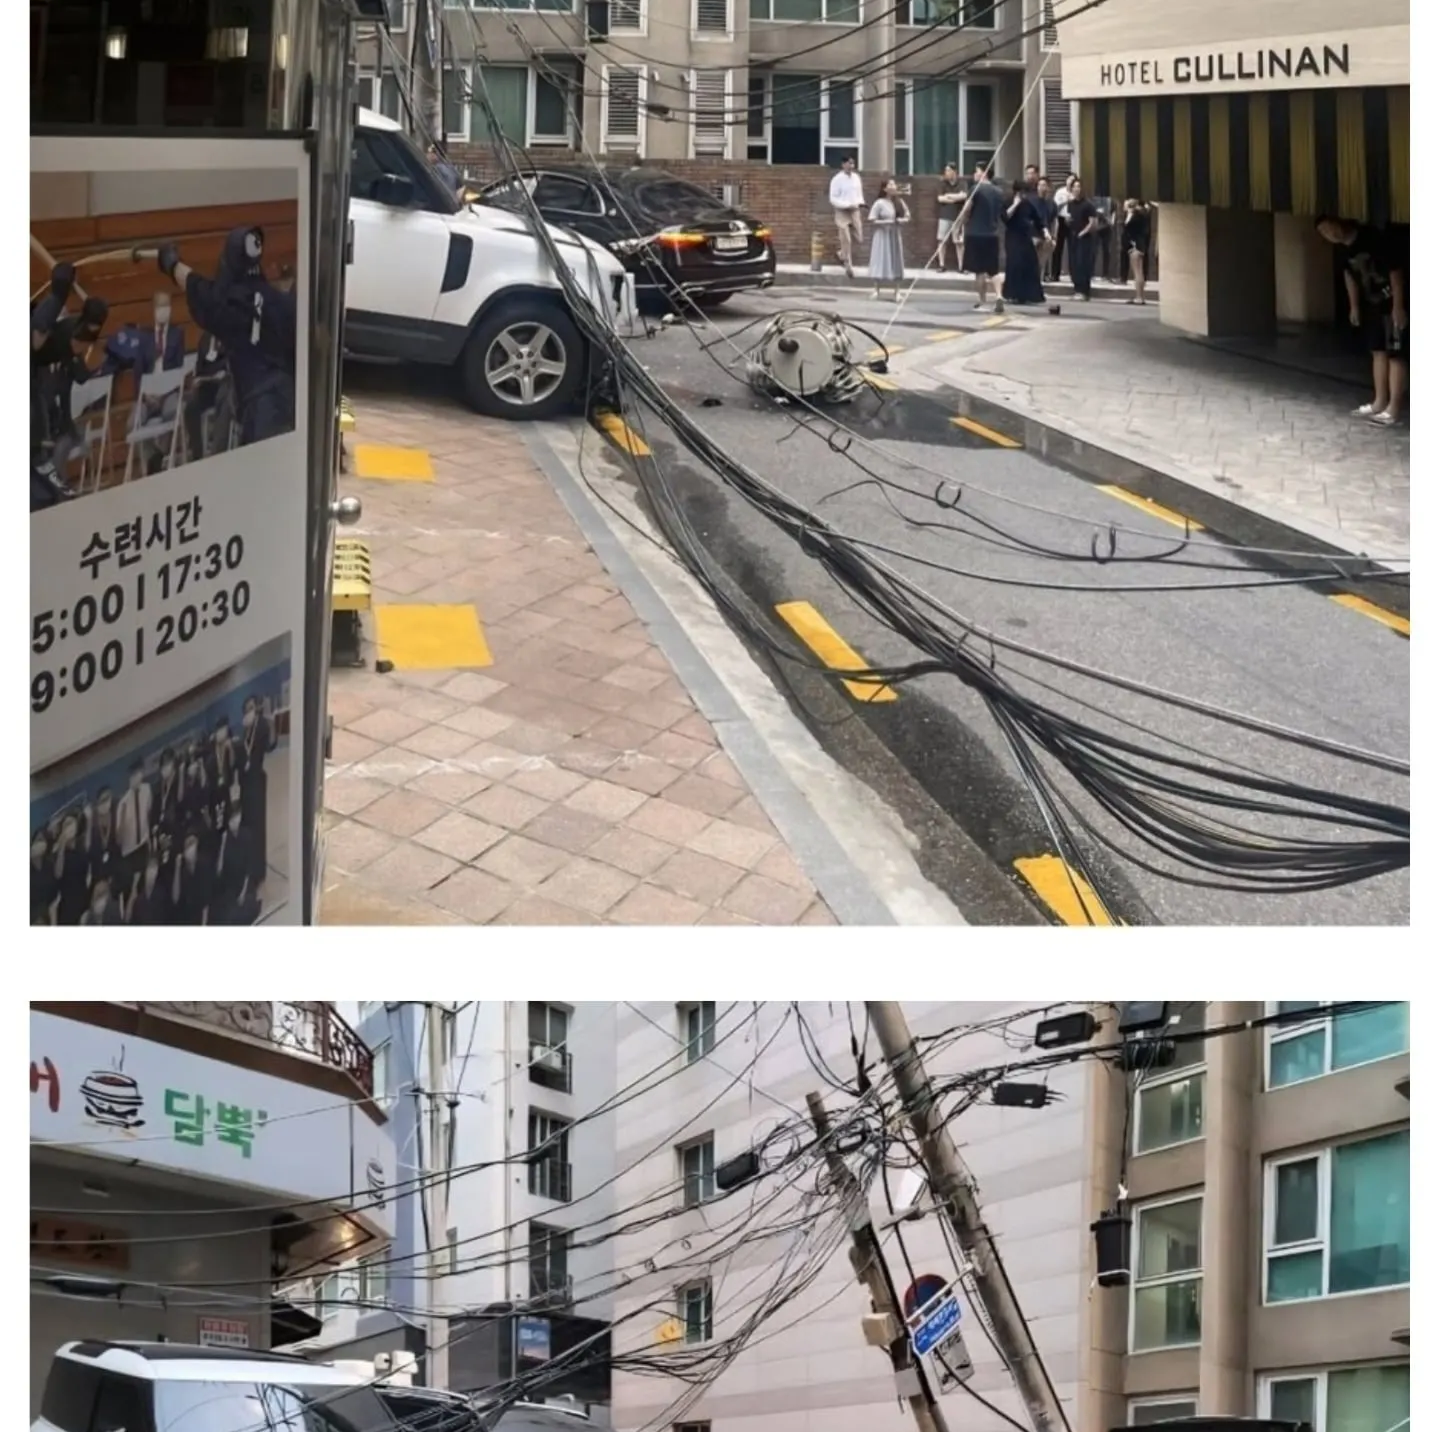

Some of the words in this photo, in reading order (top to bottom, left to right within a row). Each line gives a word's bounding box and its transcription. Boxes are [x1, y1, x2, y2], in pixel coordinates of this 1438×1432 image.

[1100, 60, 1164, 86] HOTEL
[1173, 43, 1350, 83] CULLINAN
[79, 495, 203, 580] 수련시간
[156, 534, 244, 600] 17:30
[156, 580, 250, 657] 20:30
